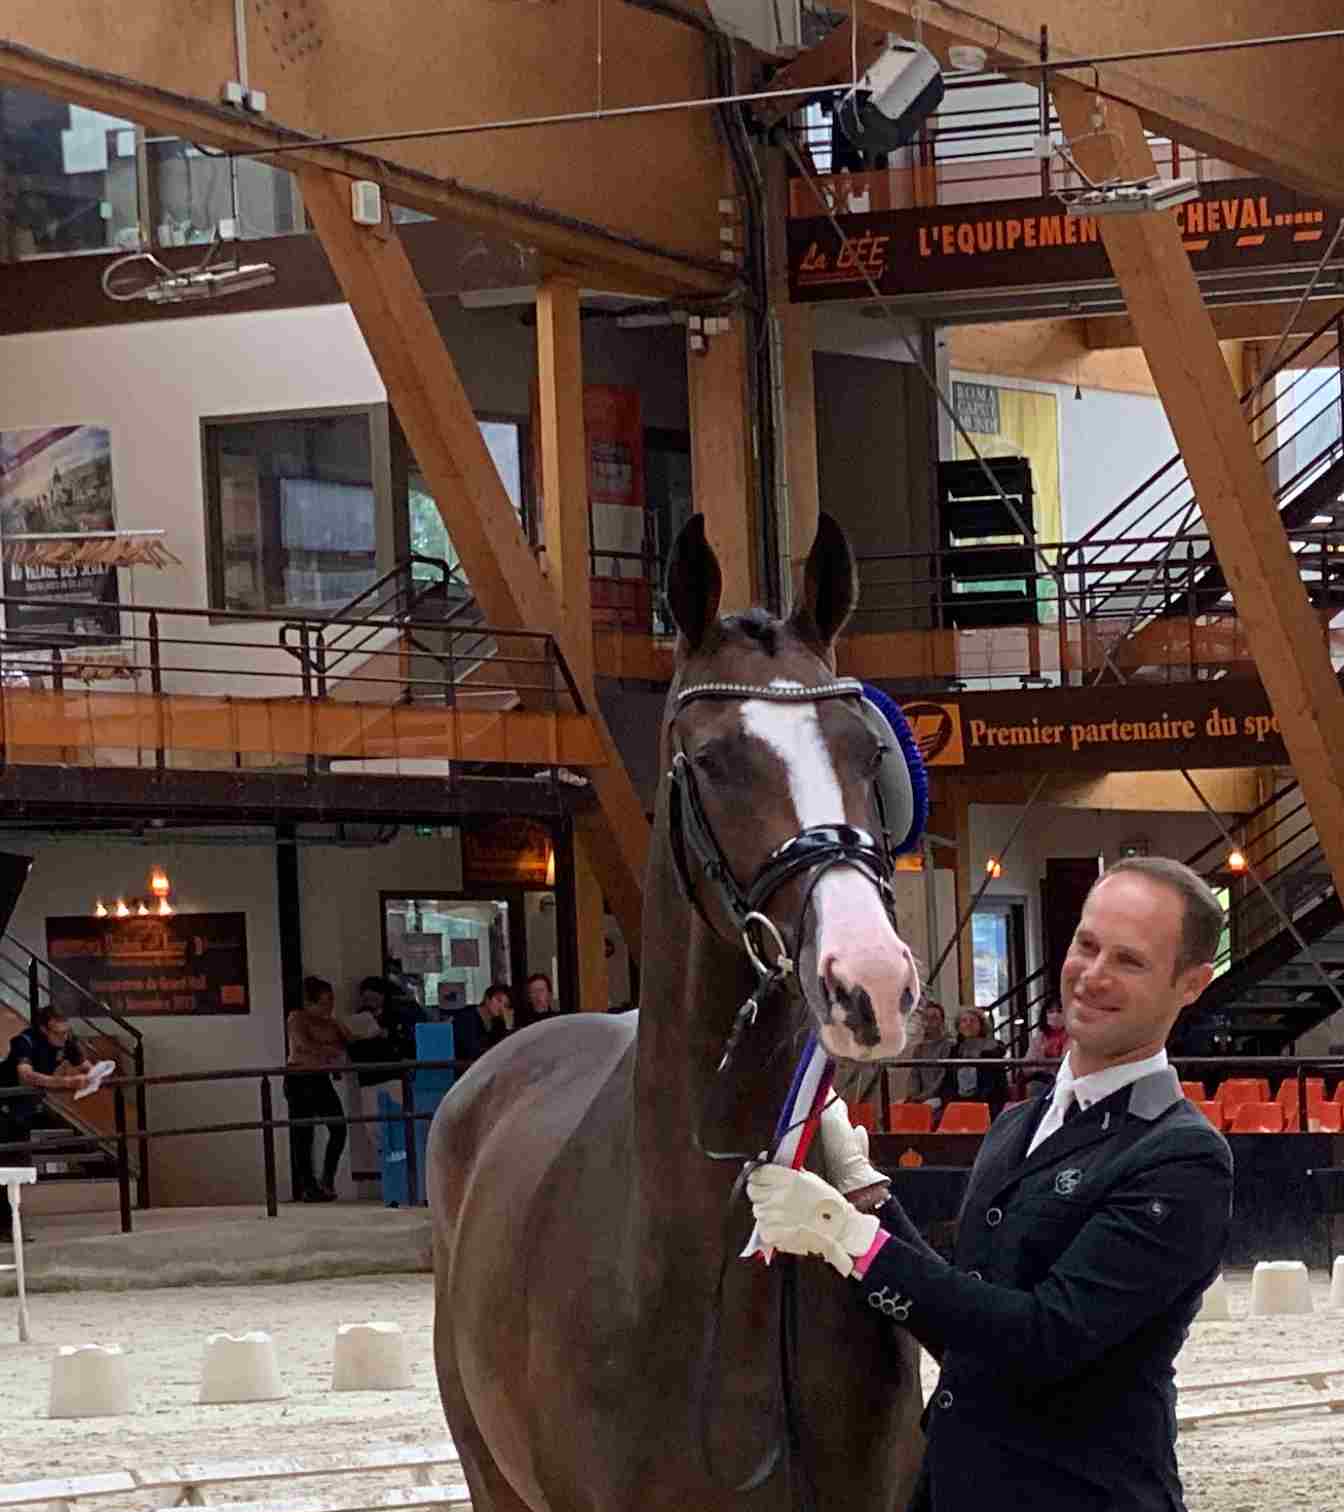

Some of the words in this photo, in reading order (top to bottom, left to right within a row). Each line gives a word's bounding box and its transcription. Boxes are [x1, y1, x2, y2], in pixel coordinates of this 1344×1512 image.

[919, 215, 1103, 257] L'EQUIPEMEN
[969, 715, 1062, 748] Premier
[1071, 714, 1196, 751] partenaire
[1205, 707, 1238, 738] du
